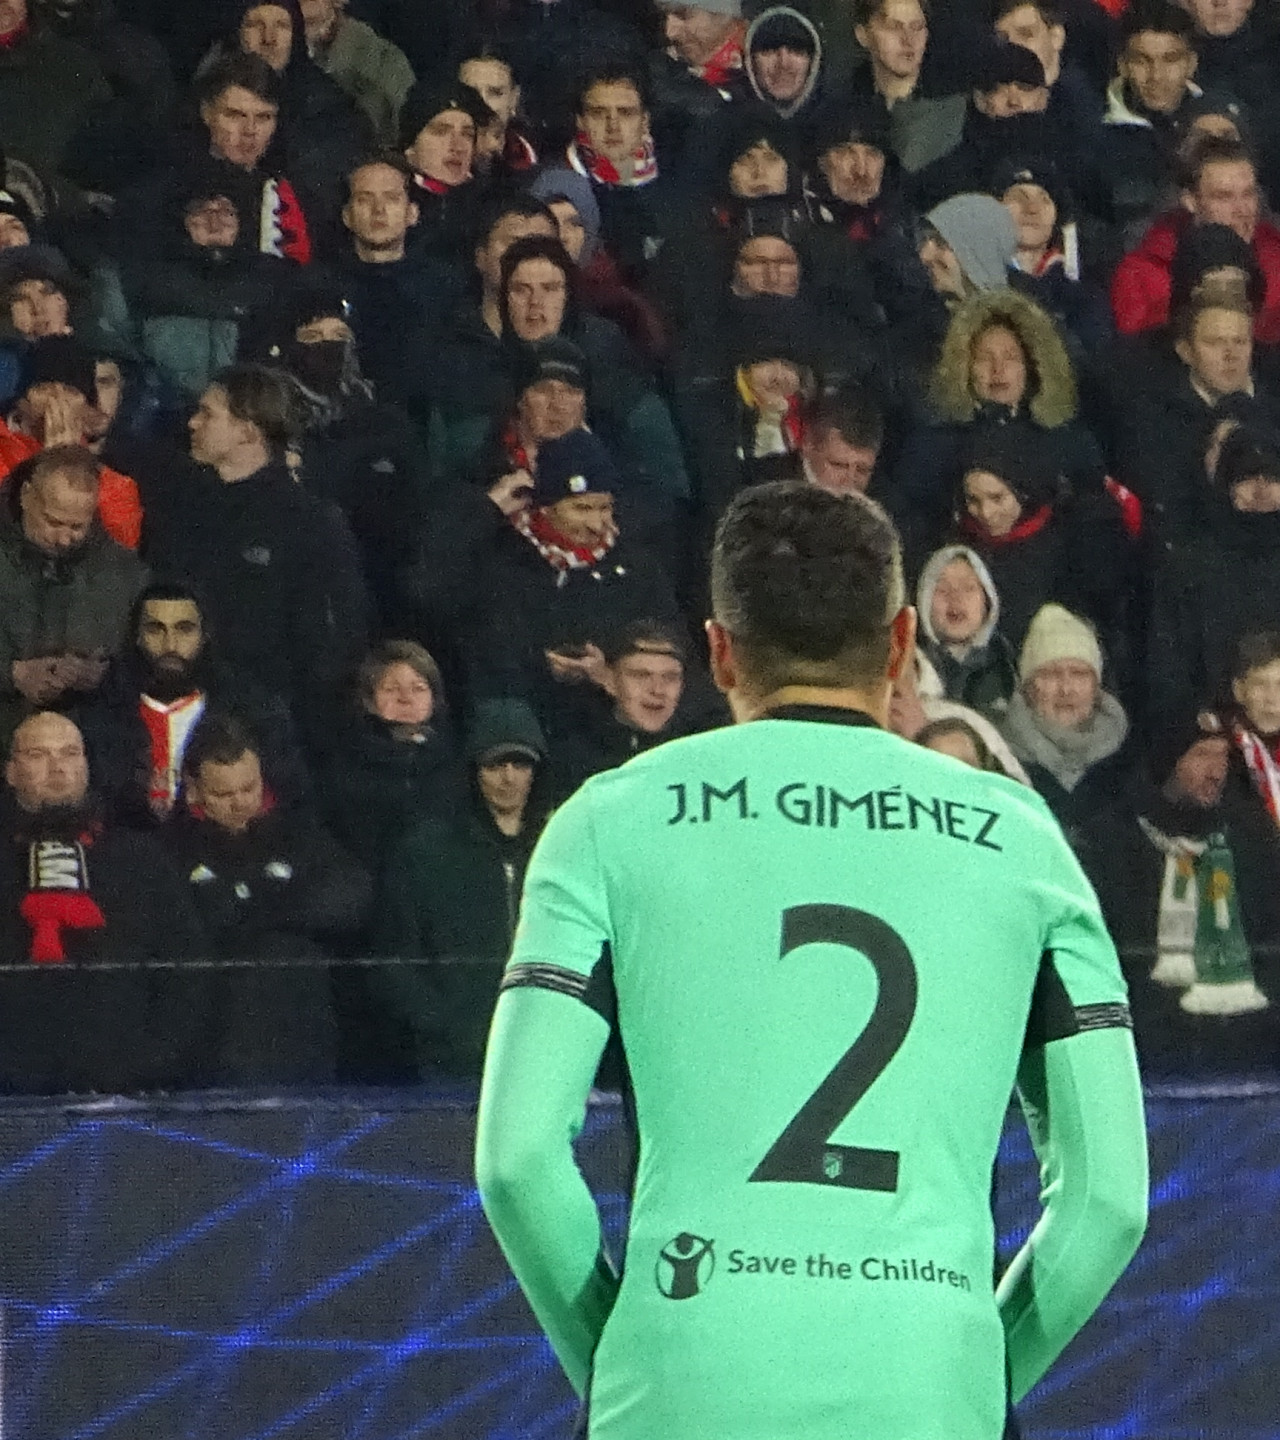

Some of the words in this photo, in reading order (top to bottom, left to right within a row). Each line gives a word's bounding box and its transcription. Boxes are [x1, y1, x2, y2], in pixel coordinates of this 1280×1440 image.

[666, 776, 759, 826] J.M.
[775, 783, 1003, 852] GIMÉNEZ
[747, 902, 919, 1193] 2
[726, 1248, 797, 1275] Save
[804, 1253, 852, 1280] the
[860, 1257, 971, 1292] Children
